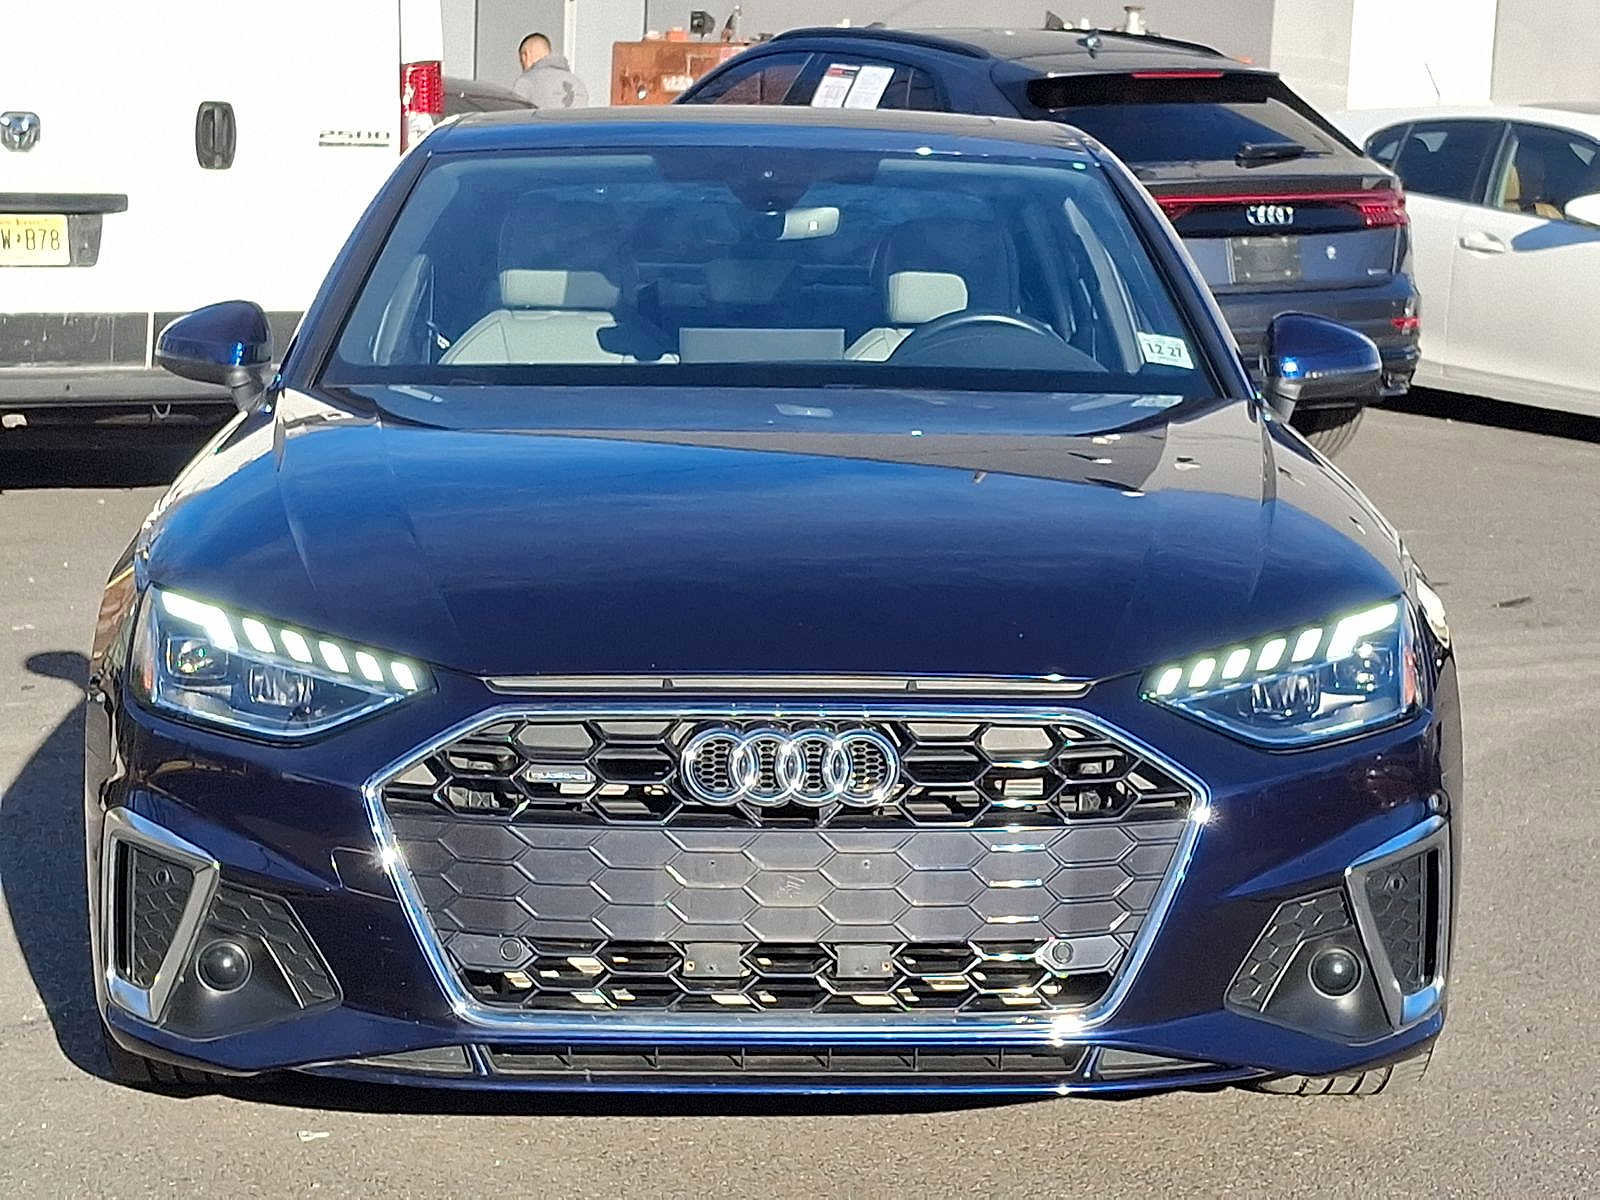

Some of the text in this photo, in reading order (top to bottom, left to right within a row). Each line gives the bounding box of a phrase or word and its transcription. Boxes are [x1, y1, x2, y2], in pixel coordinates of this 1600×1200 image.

[319, 129, 390, 147] 2500
[1147, 343, 1182, 358] 12 27
